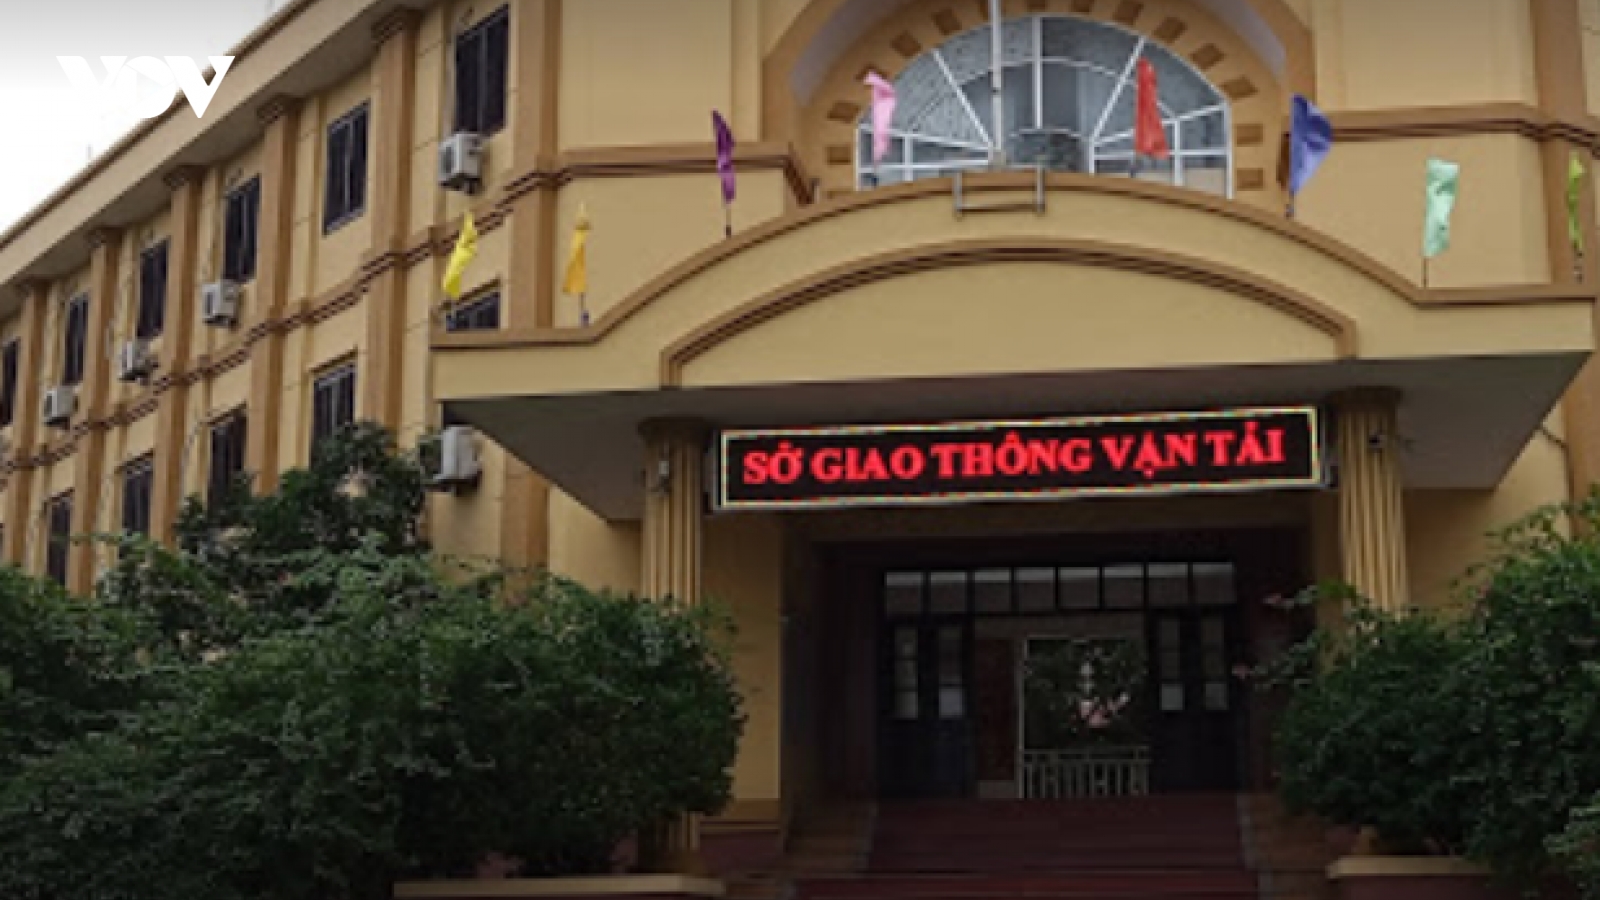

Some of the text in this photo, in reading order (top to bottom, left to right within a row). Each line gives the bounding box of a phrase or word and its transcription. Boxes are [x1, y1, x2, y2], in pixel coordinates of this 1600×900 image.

[742, 441, 803, 484] SỞ
[810, 445, 925, 483] GIAO
[931, 432, 1092, 477] THÔNG
[1204, 421, 1286, 466] TẢI
